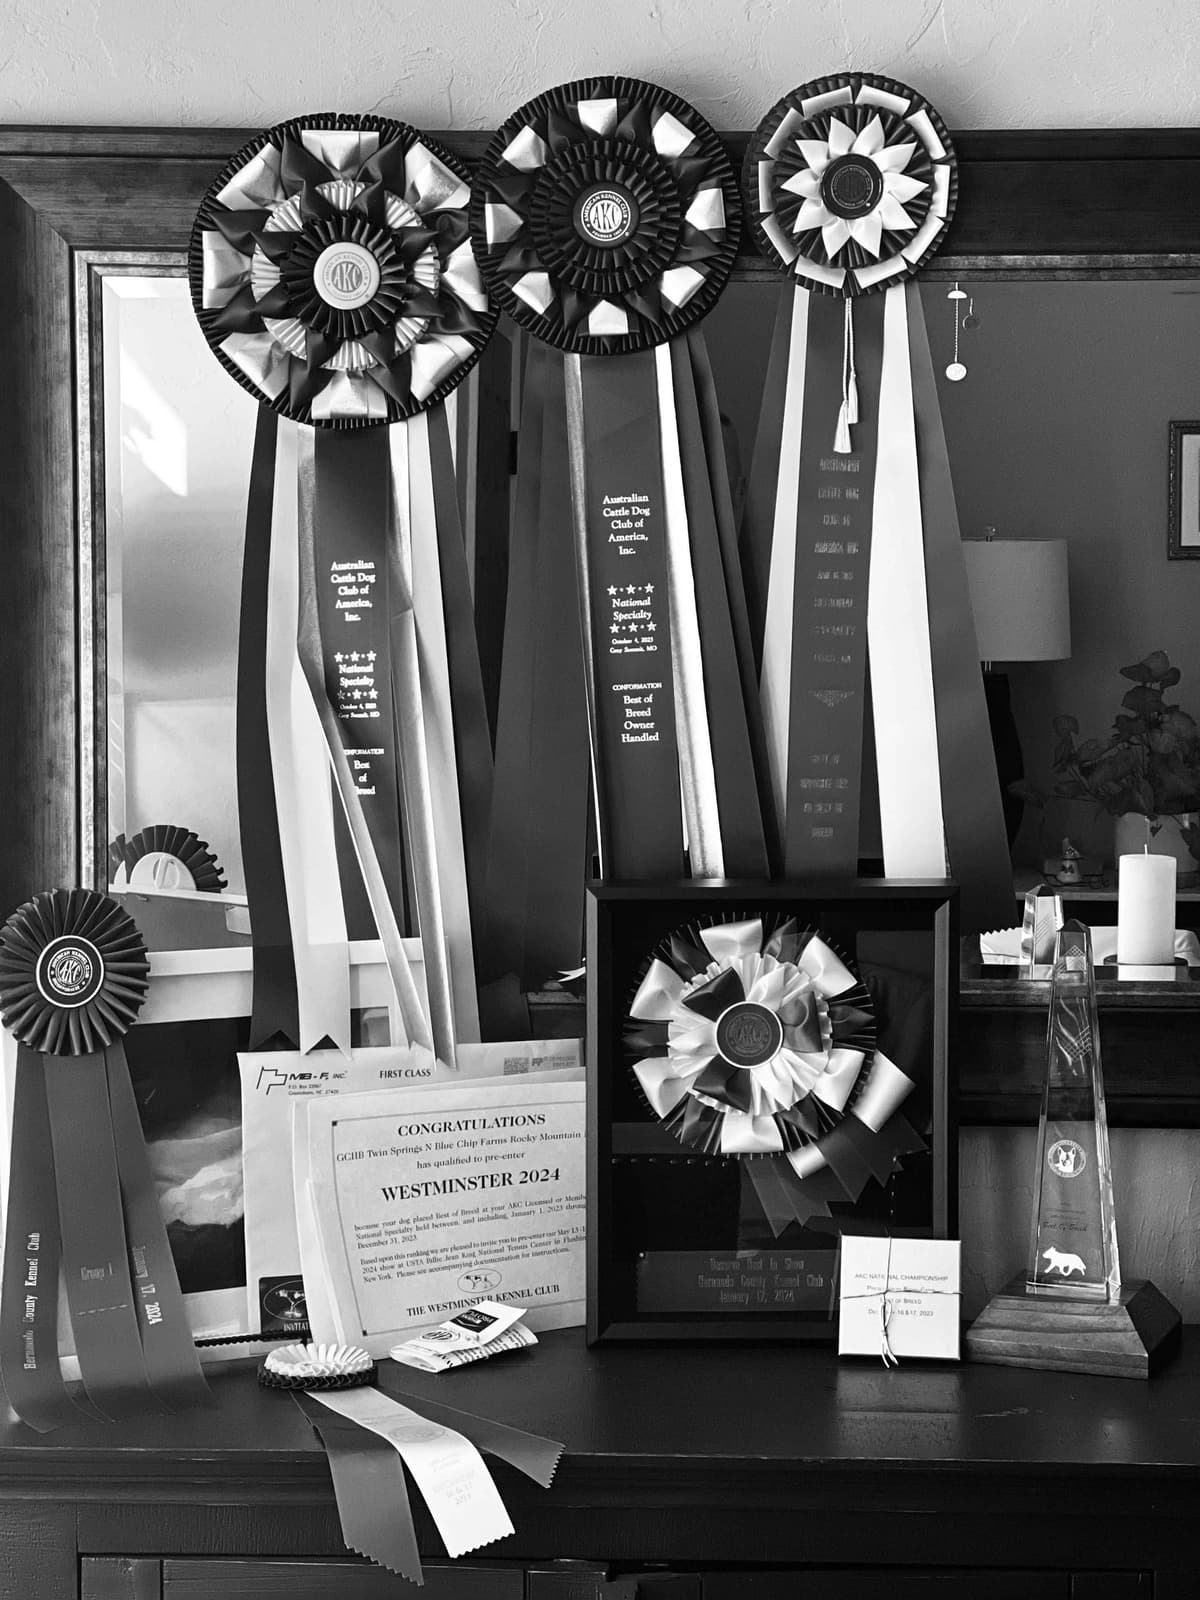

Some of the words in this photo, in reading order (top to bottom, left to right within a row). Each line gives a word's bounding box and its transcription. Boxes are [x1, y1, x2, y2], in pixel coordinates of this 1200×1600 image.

[592, 202, 621, 231] AKC
[332, 261, 362, 292] AKC
[602, 493, 649, 505] Australian
[602, 507, 630, 518] Cattle
[632, 506, 651, 518] Dog
[610, 520, 634, 529] Club
[634, 518, 644, 528] of
[608, 532, 649, 543] America,
[618, 546, 636, 556] Inc.
[330, 560, 376, 570] Australian
[330, 573, 356, 583] Cattle
[357, 572, 376, 583] Dog
[338, 585, 359, 595] Club
[360, 584, 370, 594] of
[335, 598, 373, 609] America,
[612, 597, 651, 608] National
[344, 612, 362, 622] Inc.
[612, 610, 652, 622] Specialty
[338, 662, 374, 674] National
[339, 676, 374, 688] Specialty
[612, 682, 662, 691] CONFORMATION
[623, 695, 642, 704] Best
[643, 694, 653, 703] of
[625, 708, 652, 718] Breed
[624, 720, 655, 730] Owner
[621, 732, 660, 743] Handled
[354, 760, 370, 769] Best
[359, 772, 367, 782] of
[59, 960, 81, 984] AKC
[379, 1070, 403, 1079] FIRST
[404, 1068, 432, 1078] CLASS
[398, 1114, 546, 1137] CONGRATULATIONS
[367, 1149, 388, 1159] Twin
[390, 1145, 423, 1157] Springs
[426, 1143, 433, 1151] N
[435, 1141, 454, 1150] Blue
[457, 1139, 478, 1149] Chip
[480, 1138, 508, 1146] Farms
[510, 1134, 537, 1144] Rocky
[540, 1132, 581, 1141] Mountain
[416, 1160, 431, 1169] has
[434, 1155, 471, 1168] qualified
[485, 1152, 525, 1163] pre-enter
[381, 1172, 514, 1202] WESTMINSTER
[519, 1168, 560, 1185] 2024
[413, 1214, 433, 1224] placed
[525, 1197, 553, 1207] Licensed
[356, 1230, 381, 1240] National
[384, 1226, 412, 1236] Specialty
[547, 1205, 563, 1213] 2023
[27, 1232, 40, 1251] Club
[358, 1238, 388, 1249] December
[407, 1250, 430, 1259] ranking
[450, 1242, 472, 1253] pleased
[480, 1239, 497, 1247] invite
[518, 1232, 545, 1242] pre-enter
[557, 1228, 570, 1236] May
[478, 1247, 504, 1256] National
[429, 1261, 472, 1273] accompanying
[474, 1254, 520, 1266] documentation
[25, 1258, 38, 1287] Kennel
[80, 1267, 104, 1281] Group
[406, 1306, 425, 1317] THE
[428, 1295, 493, 1312] WESTMINSTER
[496, 1288, 533, 1302] KENNEL
[534, 1284, 560, 1296] CLUB
[22, 1294, 38, 1323] County
[145, 1302, 163, 1325] 2024
